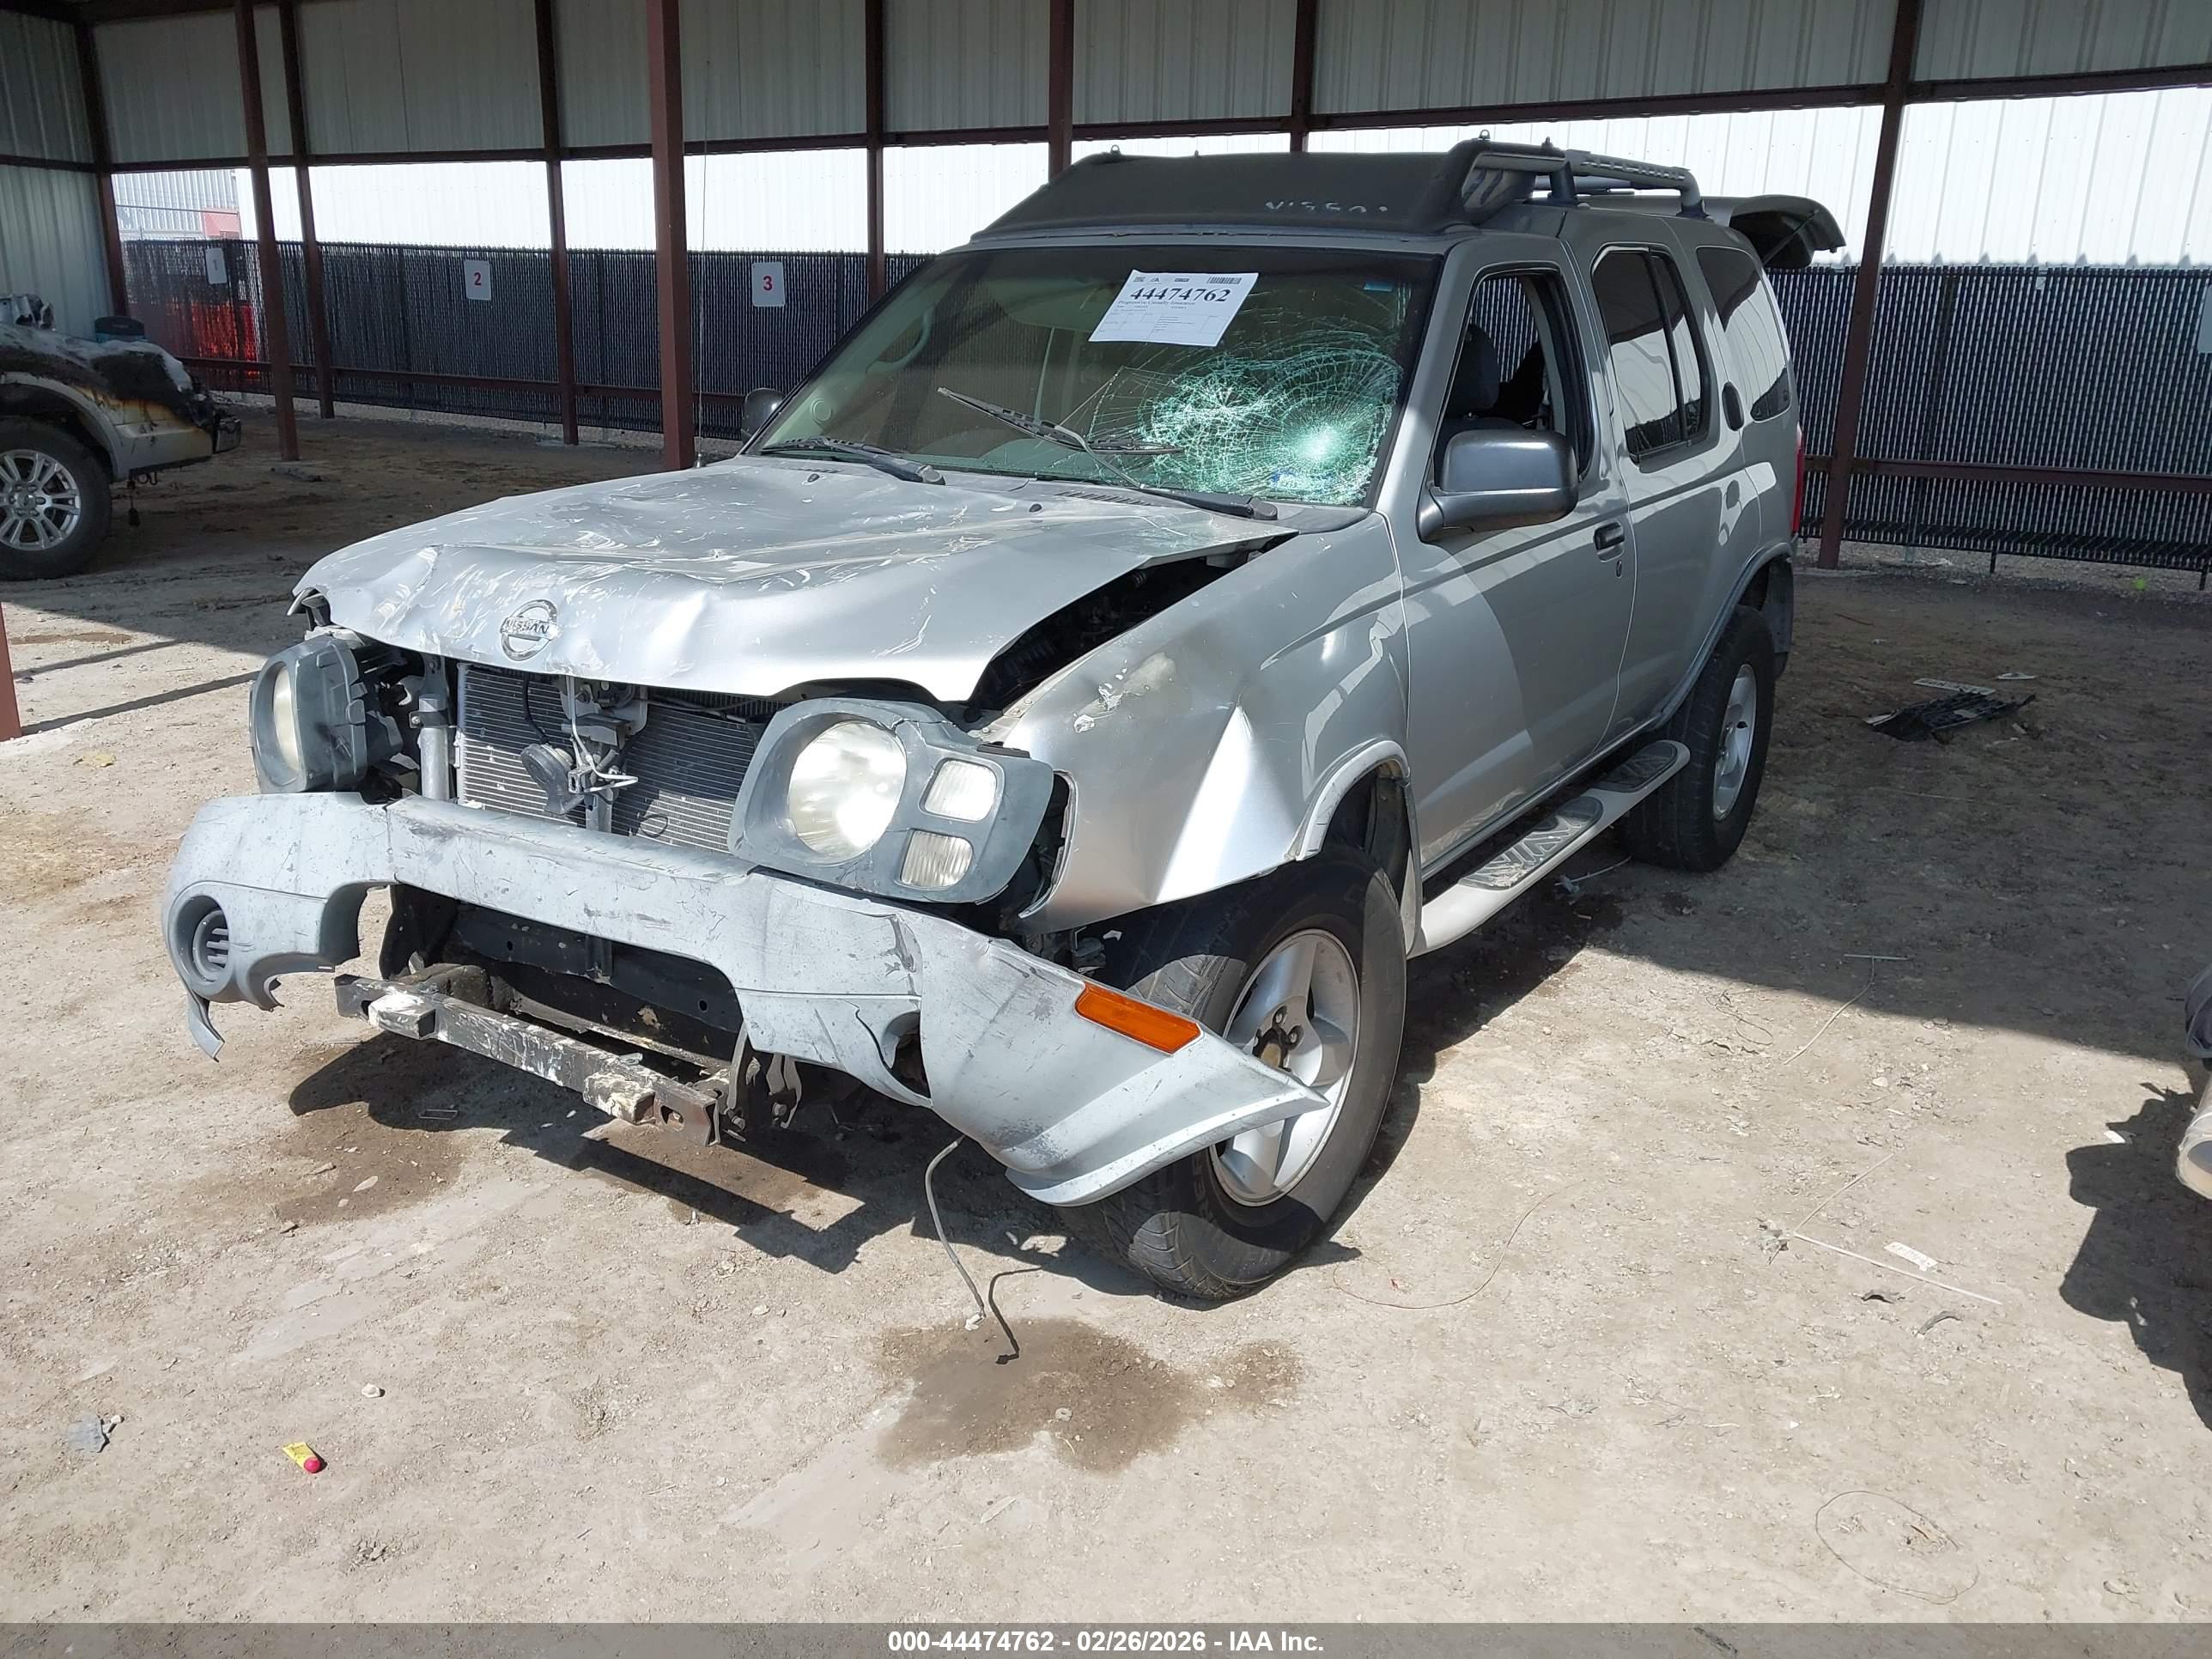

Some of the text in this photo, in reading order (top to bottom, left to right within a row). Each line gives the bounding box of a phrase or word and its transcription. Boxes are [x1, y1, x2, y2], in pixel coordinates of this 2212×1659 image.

[212, 258, 219, 271] 1
[473, 271, 482, 286] 2
[763, 275, 773, 291] 3
[1130, 288, 1231, 302] 44474762
[504, 619, 550, 635] NISSAN
